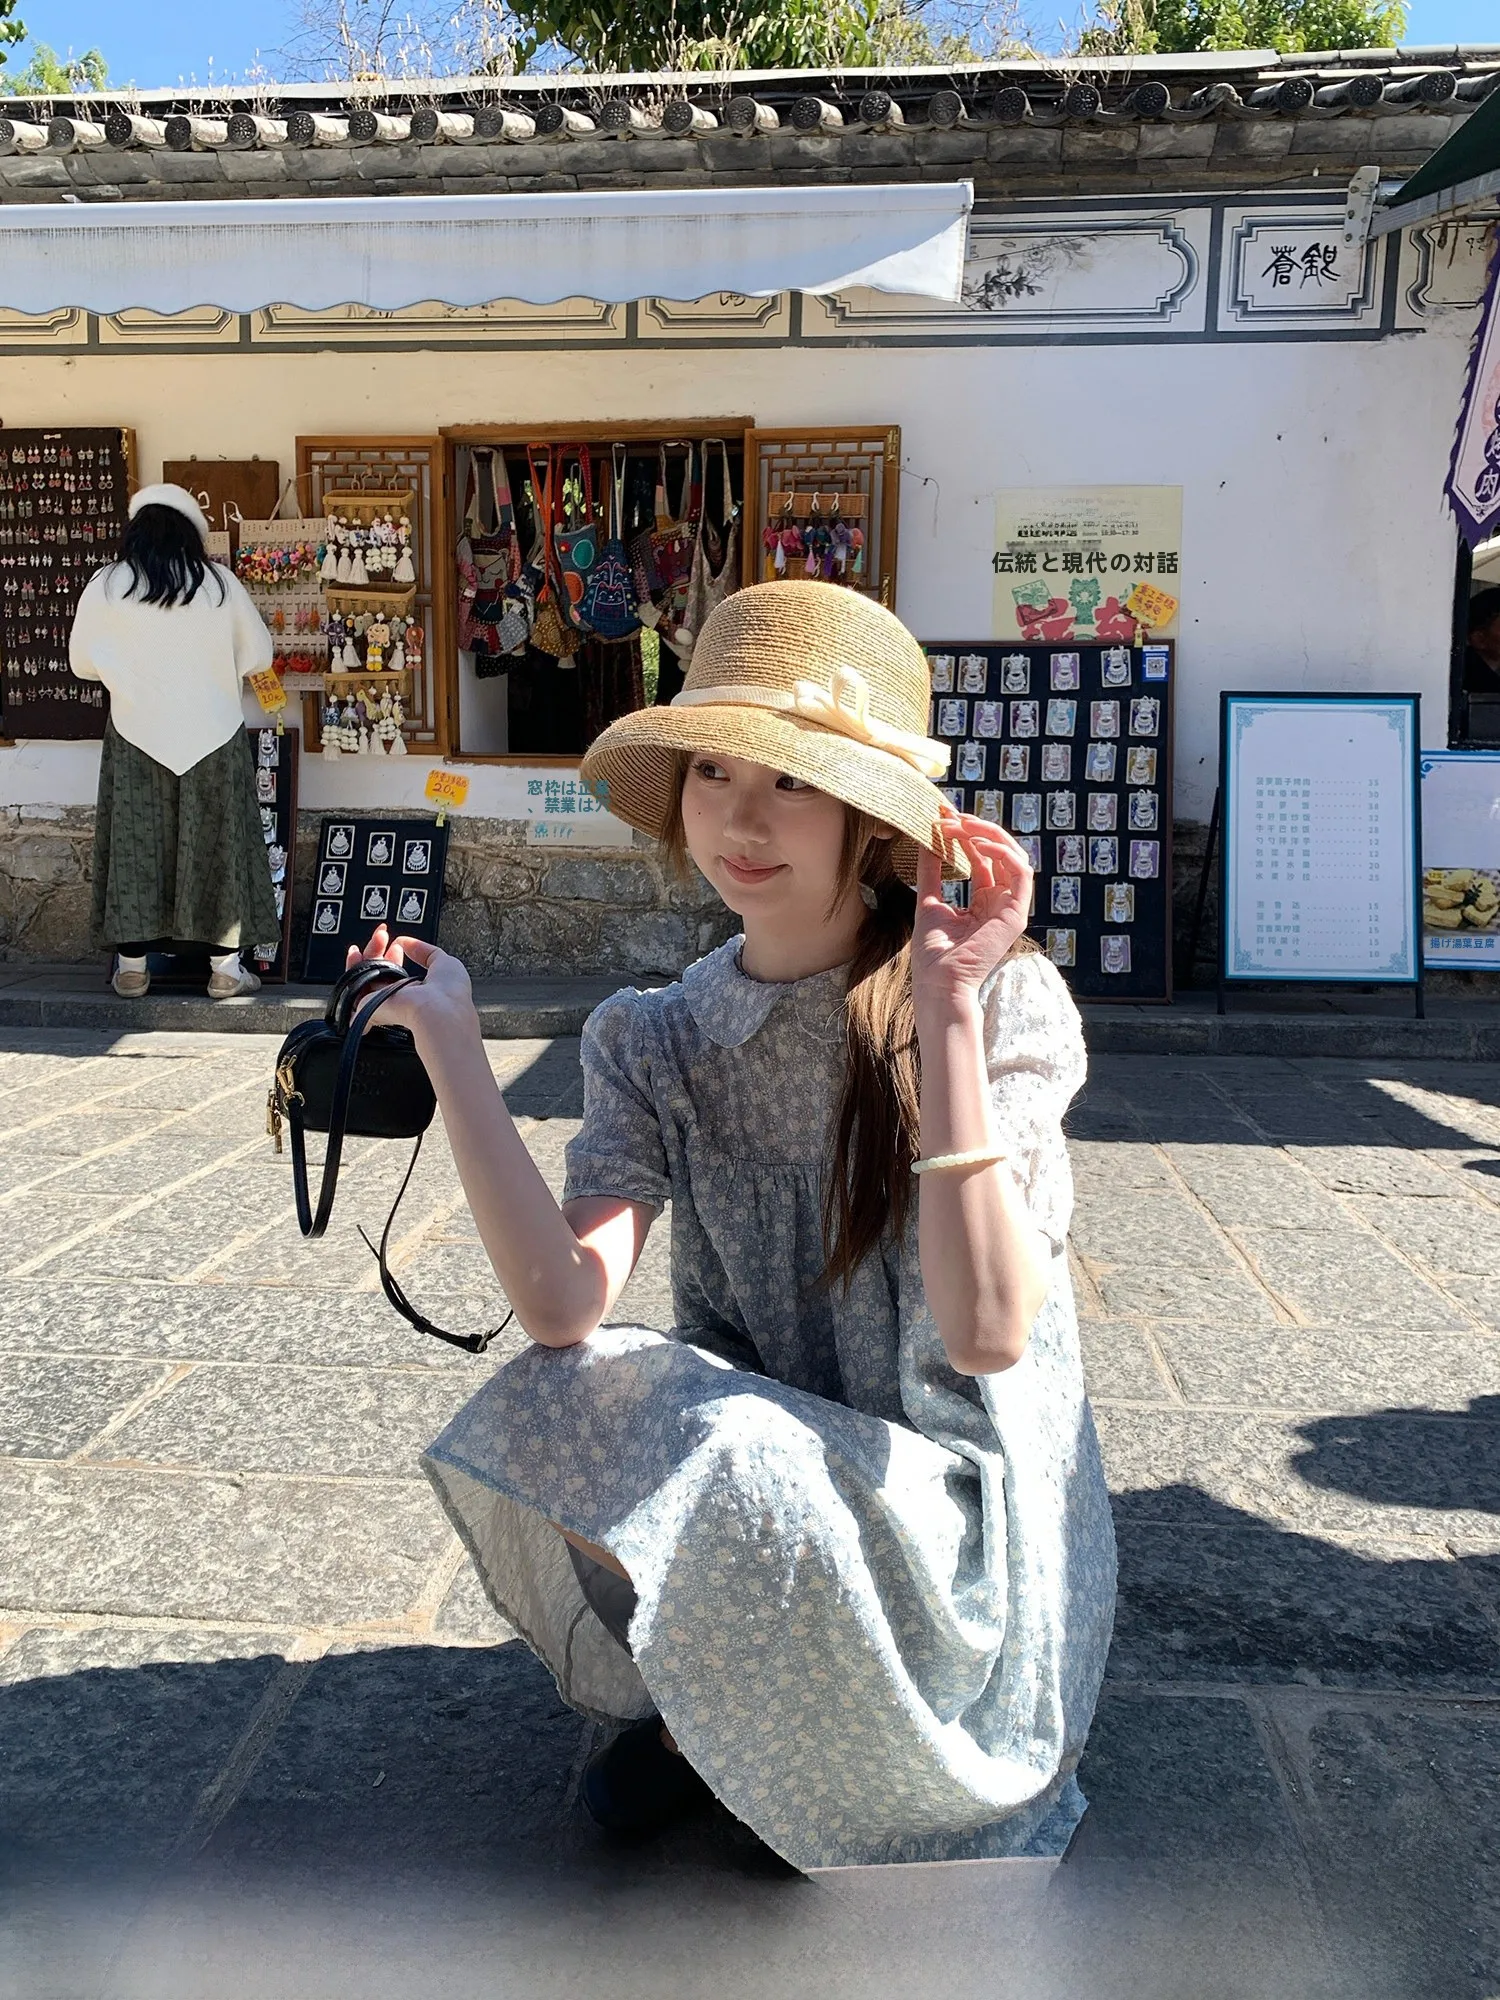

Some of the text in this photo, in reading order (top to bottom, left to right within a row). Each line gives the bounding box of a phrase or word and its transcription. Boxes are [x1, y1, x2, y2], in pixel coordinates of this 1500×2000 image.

[991, 551, 1179, 574] 伝統と現代の対話
[1430, 937, 1495, 950] 揚げ湯葉豆腐
